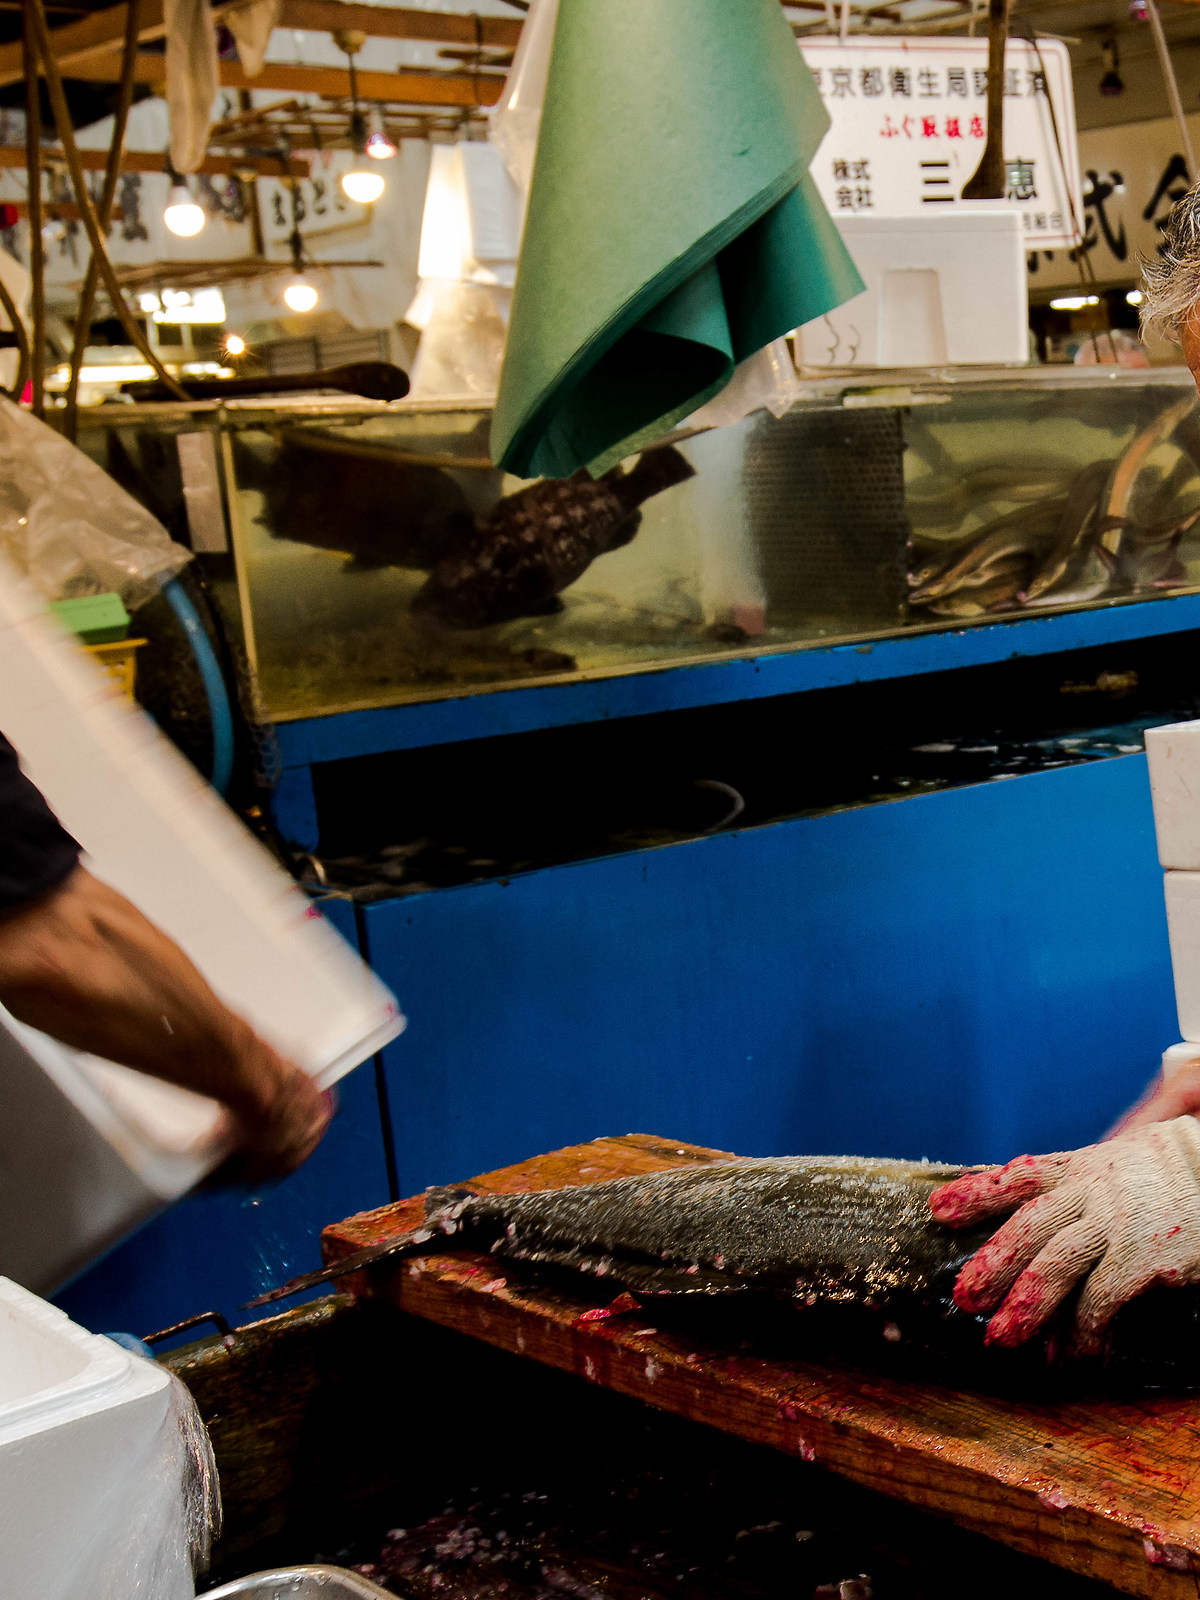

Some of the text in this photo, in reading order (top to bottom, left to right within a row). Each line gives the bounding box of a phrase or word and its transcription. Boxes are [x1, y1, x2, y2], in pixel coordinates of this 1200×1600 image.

[880, 113, 985, 138] ふぐ取扱店
